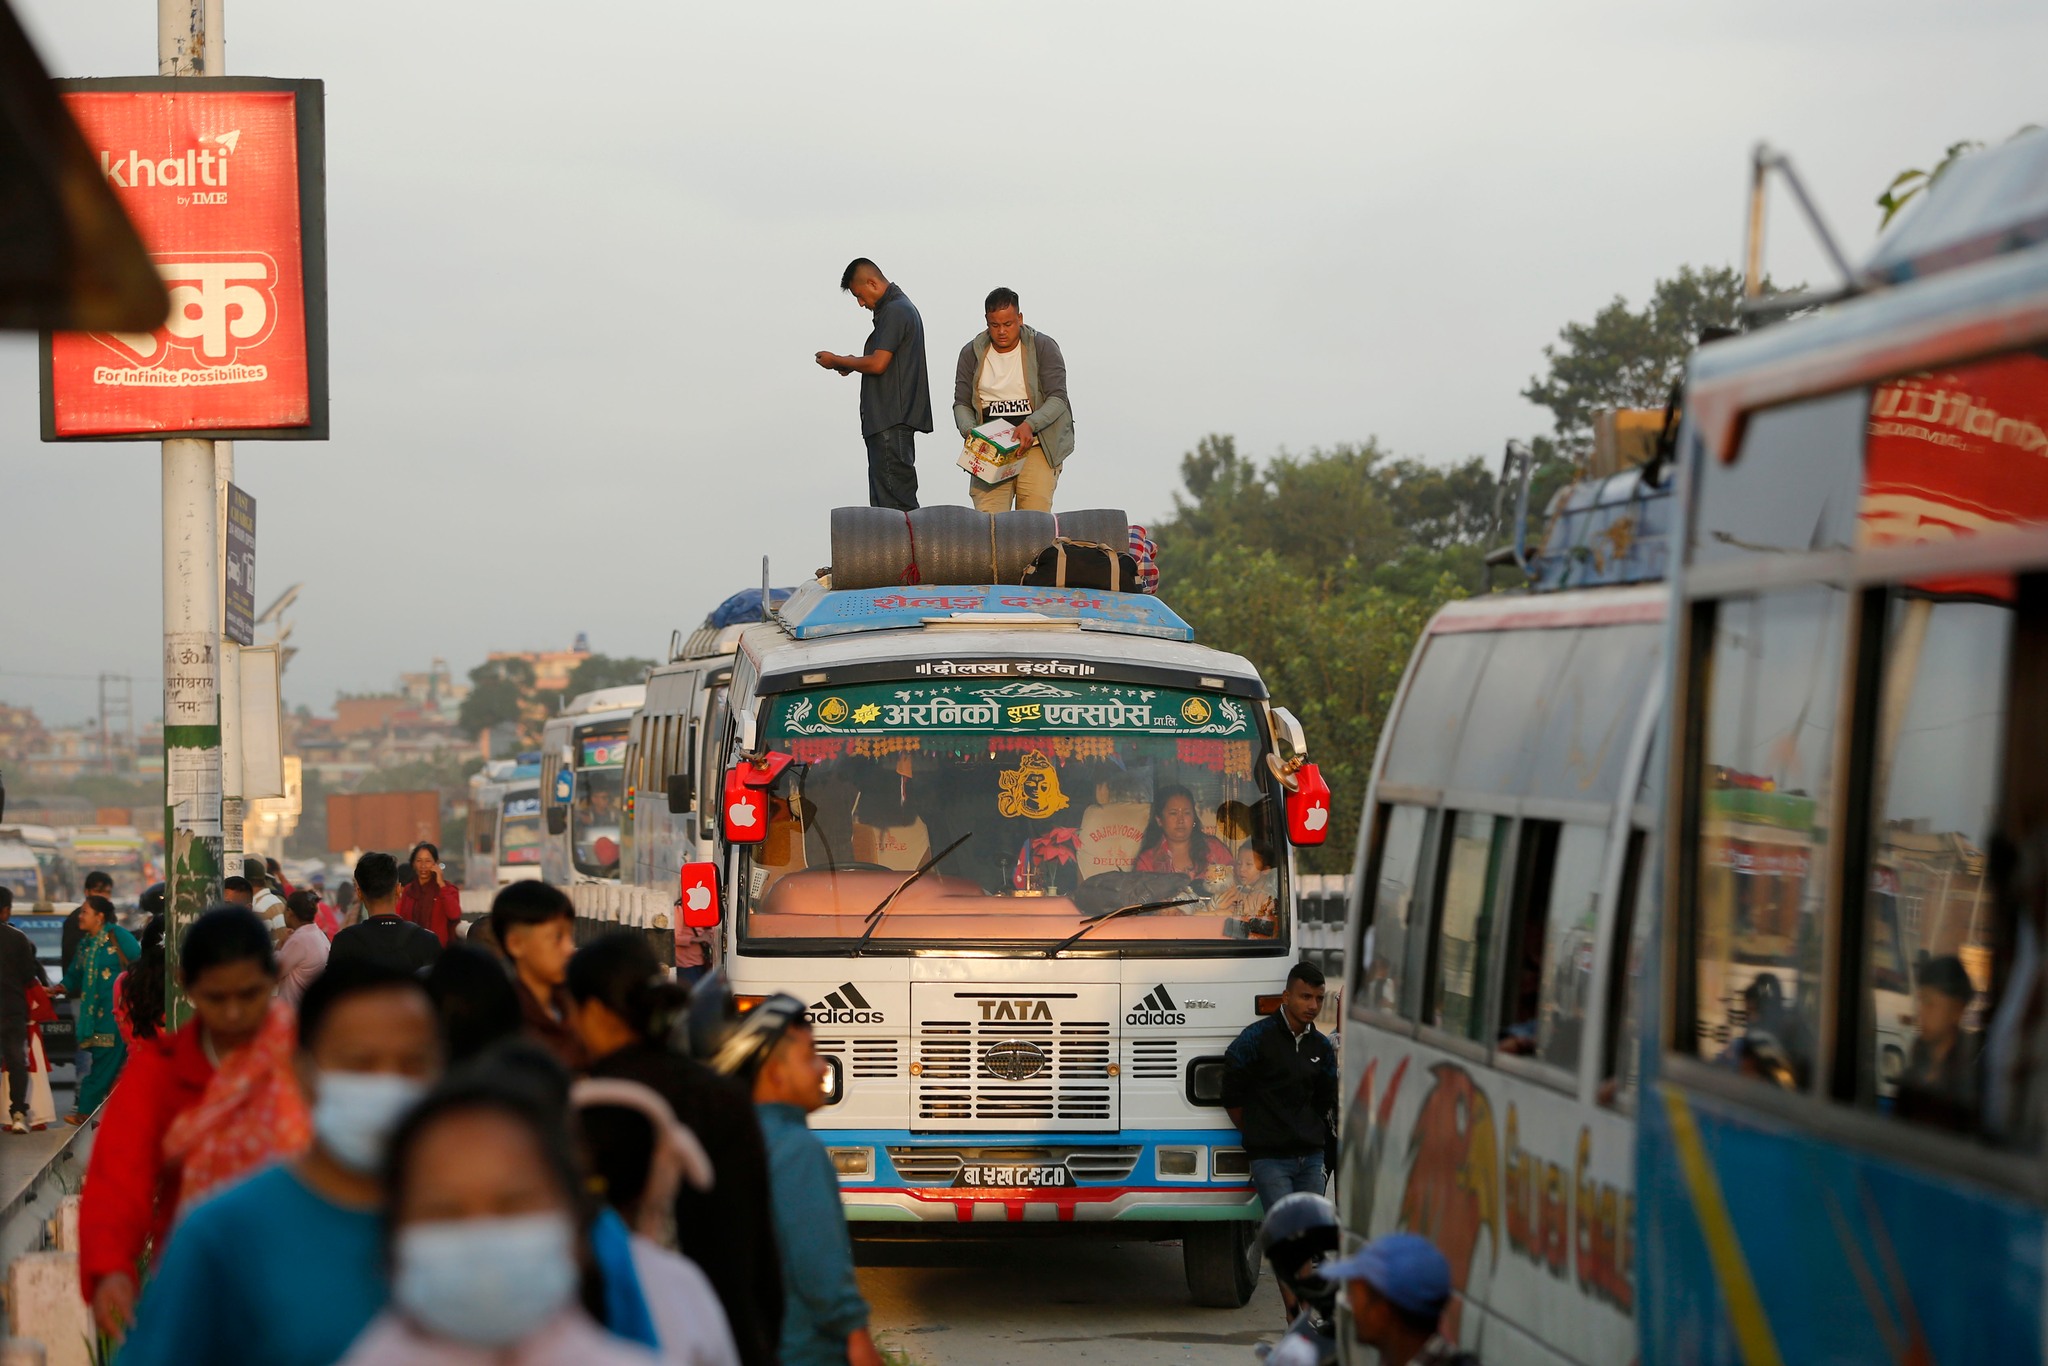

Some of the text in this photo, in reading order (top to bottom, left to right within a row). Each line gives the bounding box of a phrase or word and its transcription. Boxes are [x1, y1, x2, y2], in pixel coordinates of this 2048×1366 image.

[101, 148, 228, 188] khalti
[176, 192, 228, 208] by IME
[97, 365, 265, 383] For Infinite Possibilites
[932, 660, 1080, 676] दोलखा दर्शन
[883, 697, 1002, 726] अरनिको
[1007, 703, 1042, 723] सुपर
[1043, 698, 1152, 727] एक्सप्रेस
[805, 1008, 885, 1024] adidas
[977, 1000, 1053, 1020] TATA
[1125, 1008, 1186, 1025] adidas
